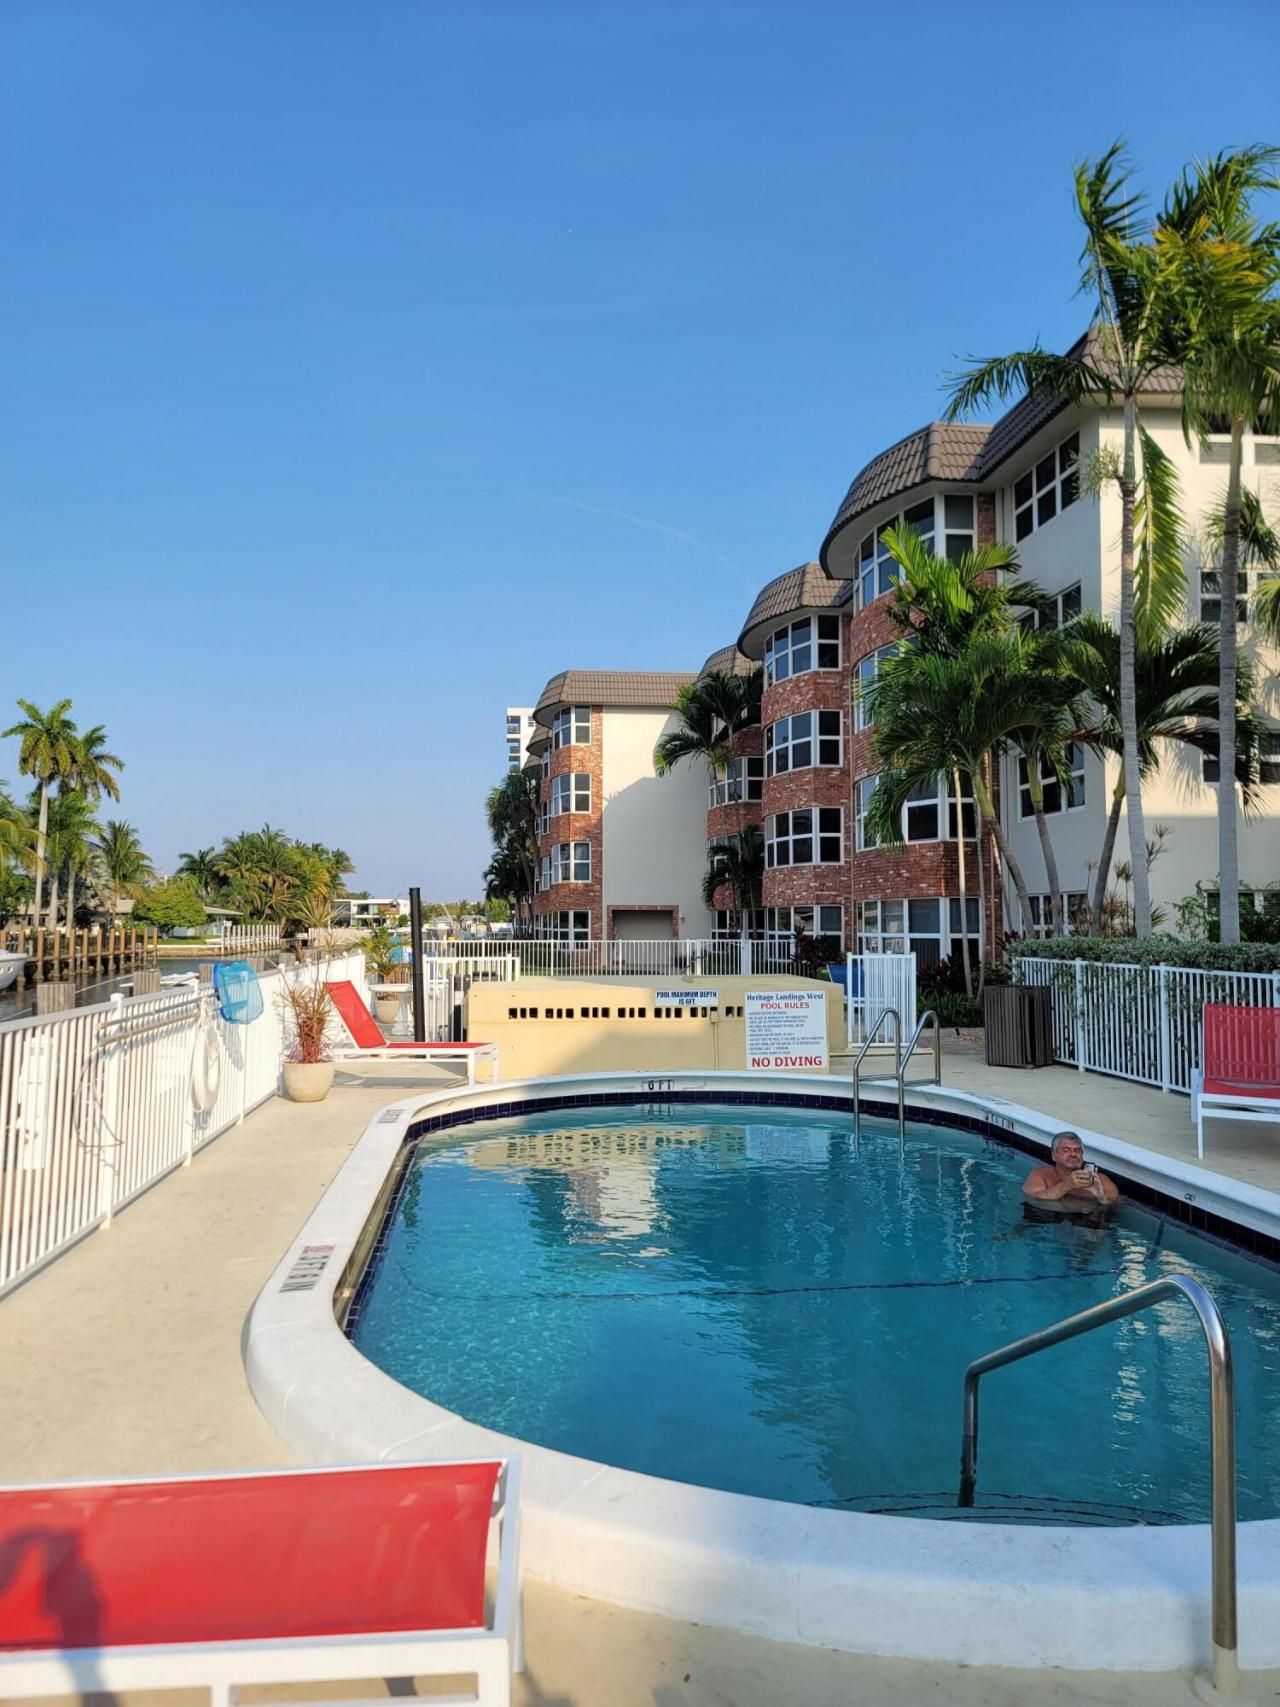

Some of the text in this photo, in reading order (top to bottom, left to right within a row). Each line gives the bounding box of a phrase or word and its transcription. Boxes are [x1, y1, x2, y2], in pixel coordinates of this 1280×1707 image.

[747, 992, 824, 1002] Heritage Landings West
[760, 1002, 782, 1010] POOL
[752, 1055, 822, 1067] NO DIVING
